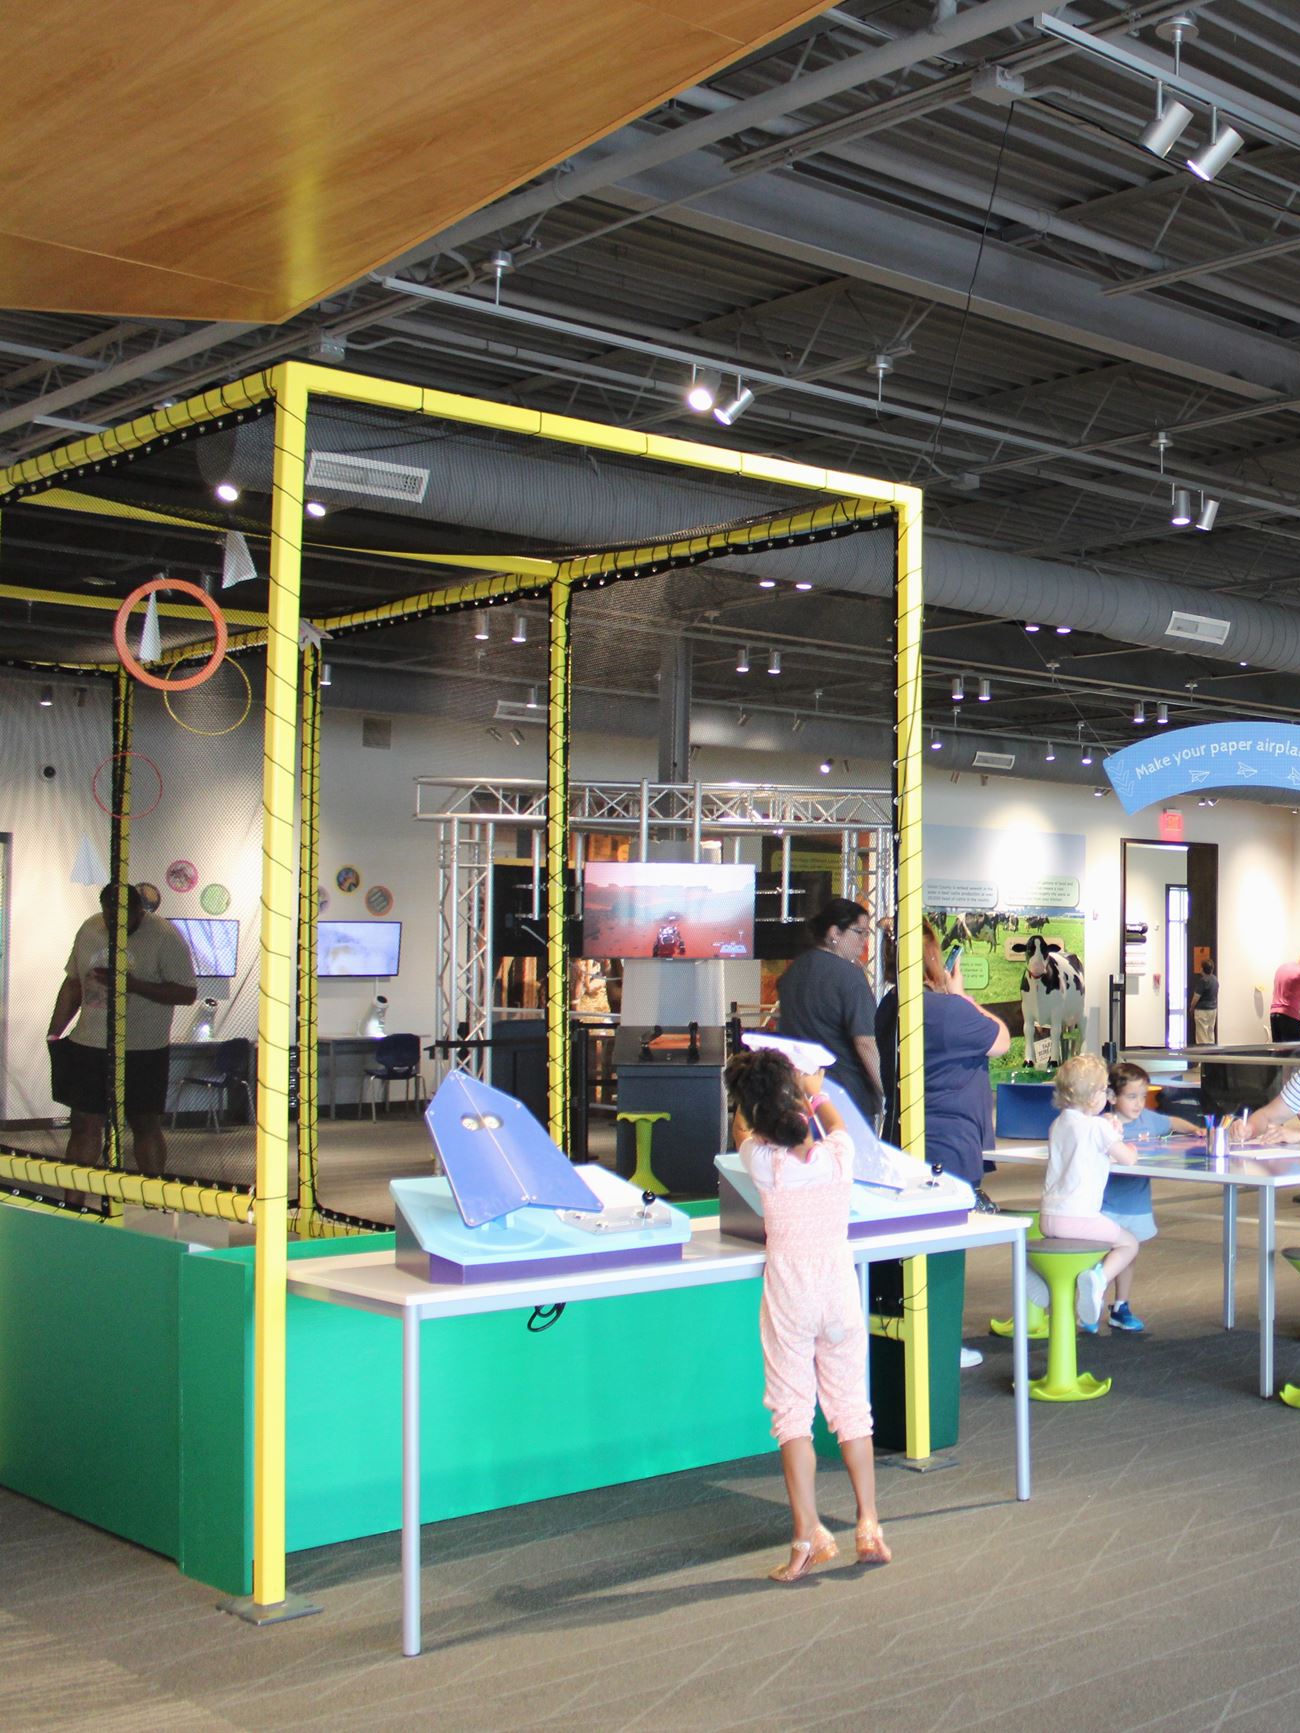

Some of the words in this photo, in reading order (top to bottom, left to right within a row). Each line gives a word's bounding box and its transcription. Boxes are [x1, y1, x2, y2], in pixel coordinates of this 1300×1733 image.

[1135, 758, 1171, 780] Make
[1172, 744, 1206, 766] your
[1210, 740, 1252, 758] paper
